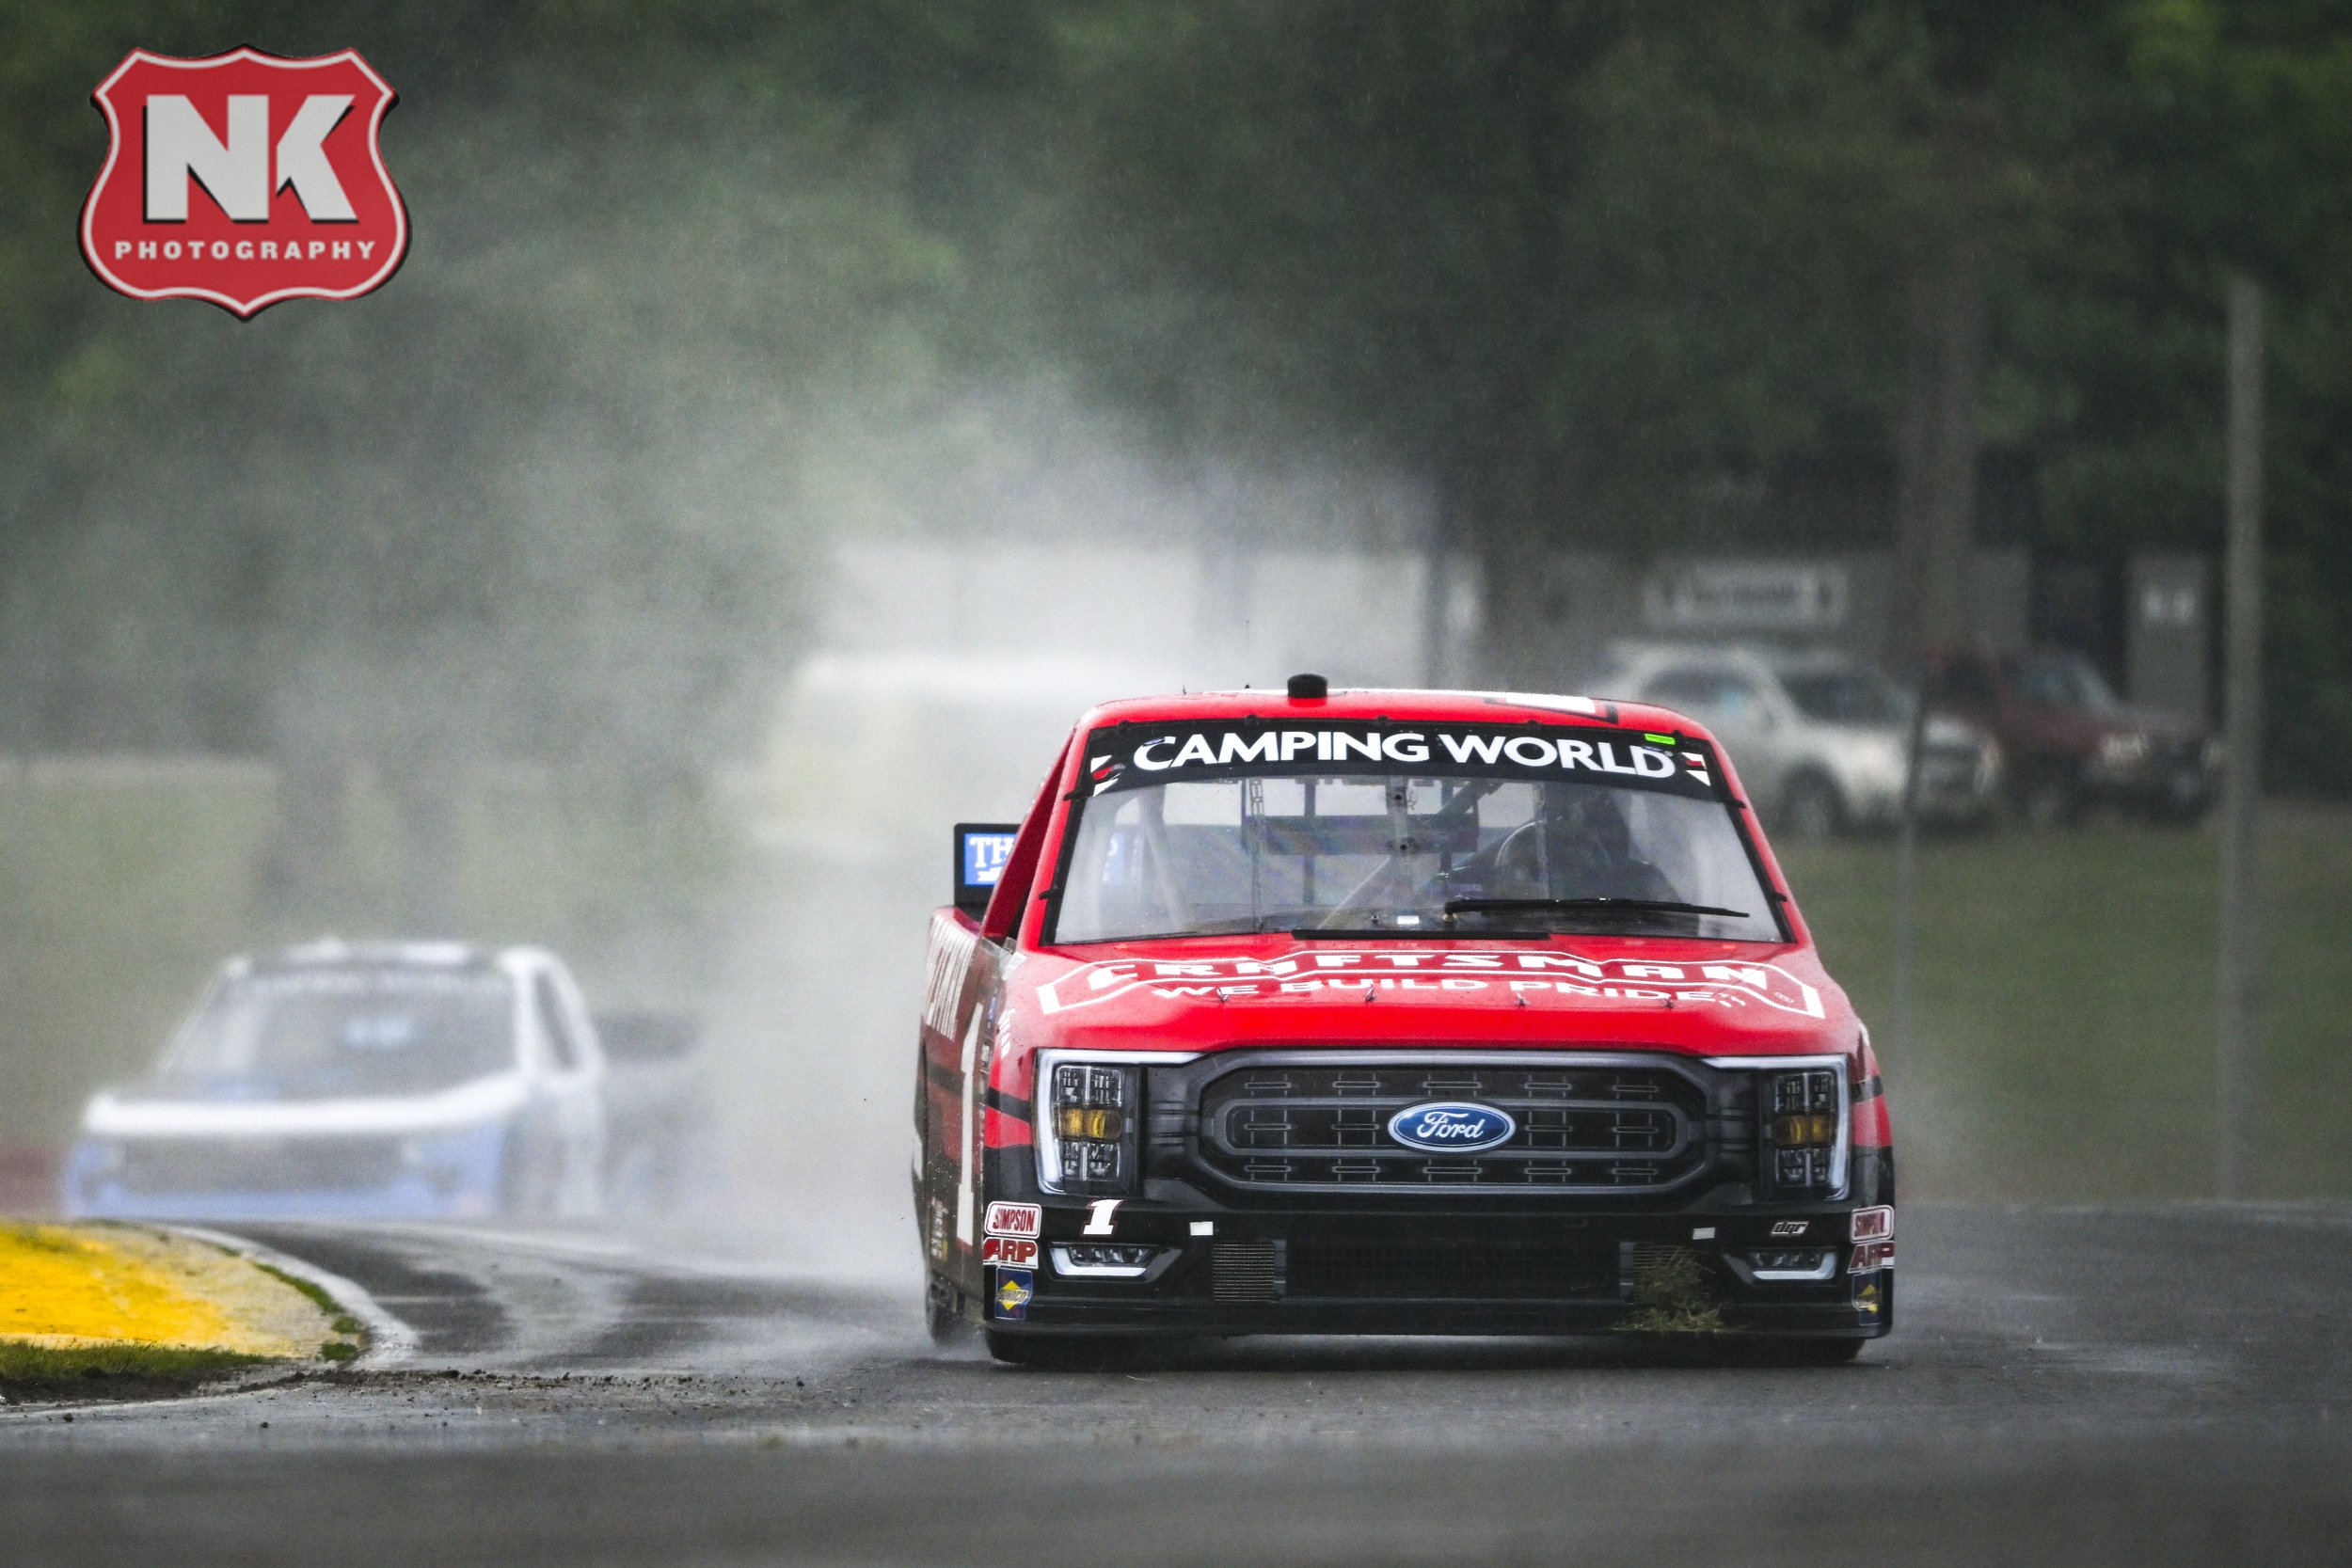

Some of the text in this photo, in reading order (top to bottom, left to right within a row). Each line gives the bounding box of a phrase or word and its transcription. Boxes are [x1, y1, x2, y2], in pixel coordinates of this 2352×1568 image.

[1133, 731, 1676, 778] CAMPING WORLD
[1151, 984, 1260, 999] WE
[1279, 978, 1489, 993] BUILD
[1509, 980, 1717, 1002] PRIDE
[1416, 1111, 1485, 1138] Ford
[992, 1207, 1036, 1232] SIMPSON
[1082, 1199, 1124, 1235] 1
[983, 1238, 1037, 1263] ARP
